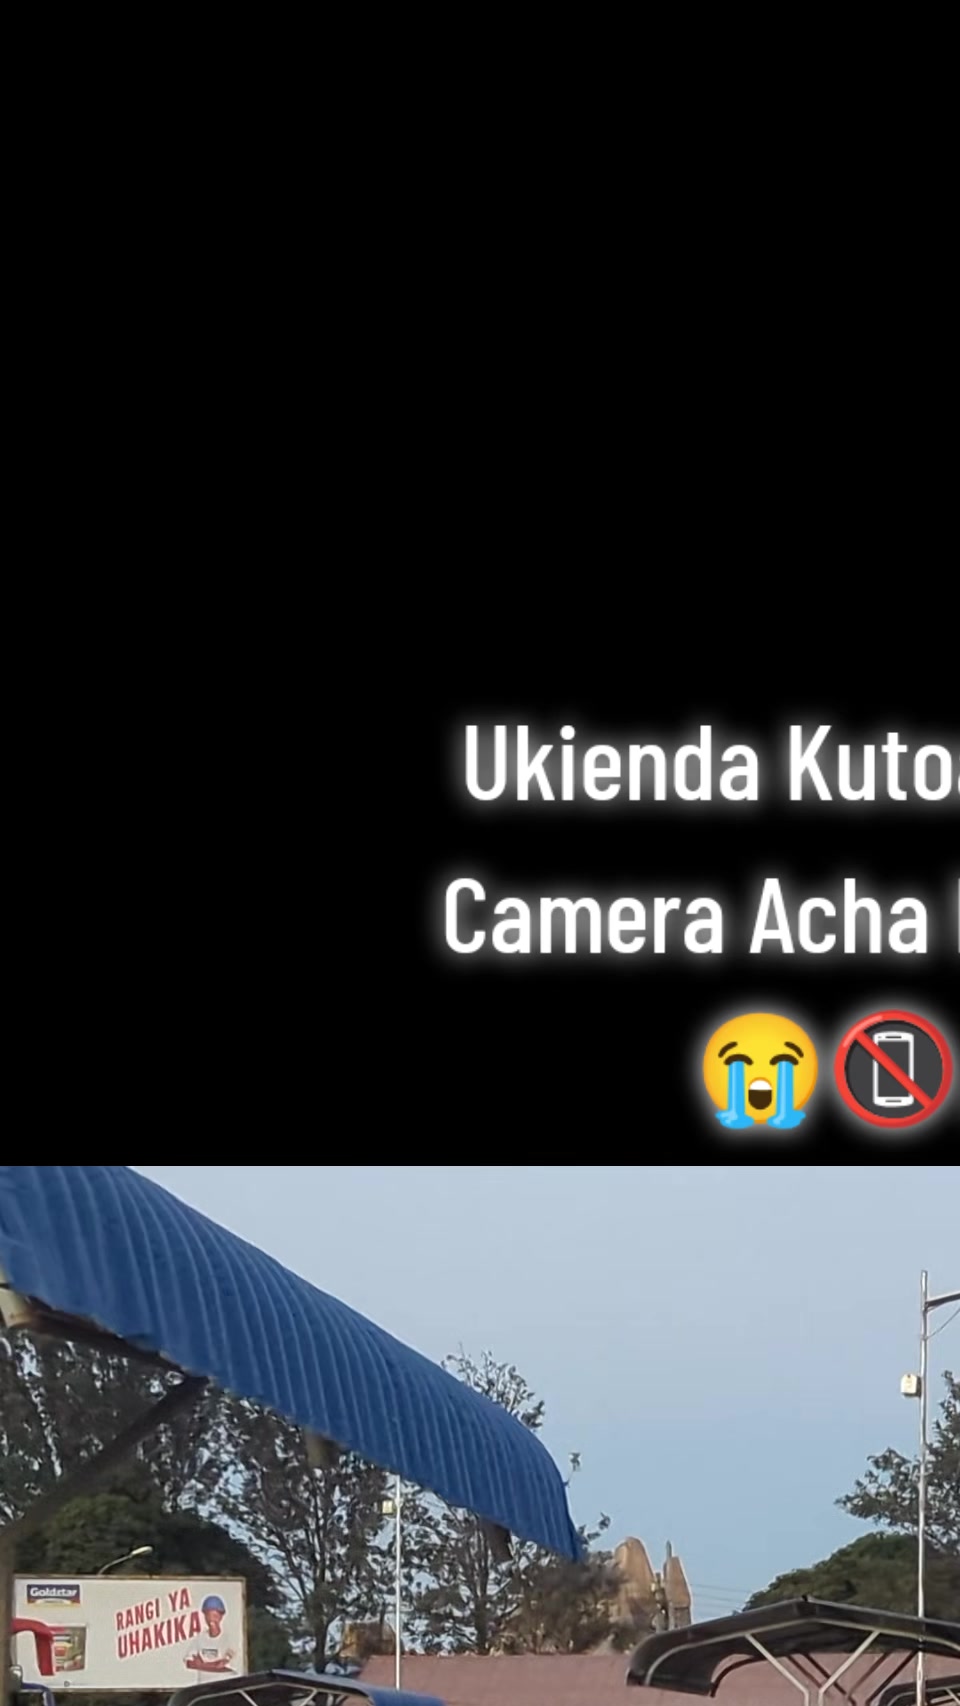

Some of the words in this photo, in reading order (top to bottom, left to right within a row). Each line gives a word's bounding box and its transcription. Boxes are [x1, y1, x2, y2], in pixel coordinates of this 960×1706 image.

[30, 1587, 77, 1597] Goldstar
[116, 1598, 160, 1630] RANGI
[169, 1588, 190, 1612] YA
[117, 1611, 202, 1659] UHAKIKA
